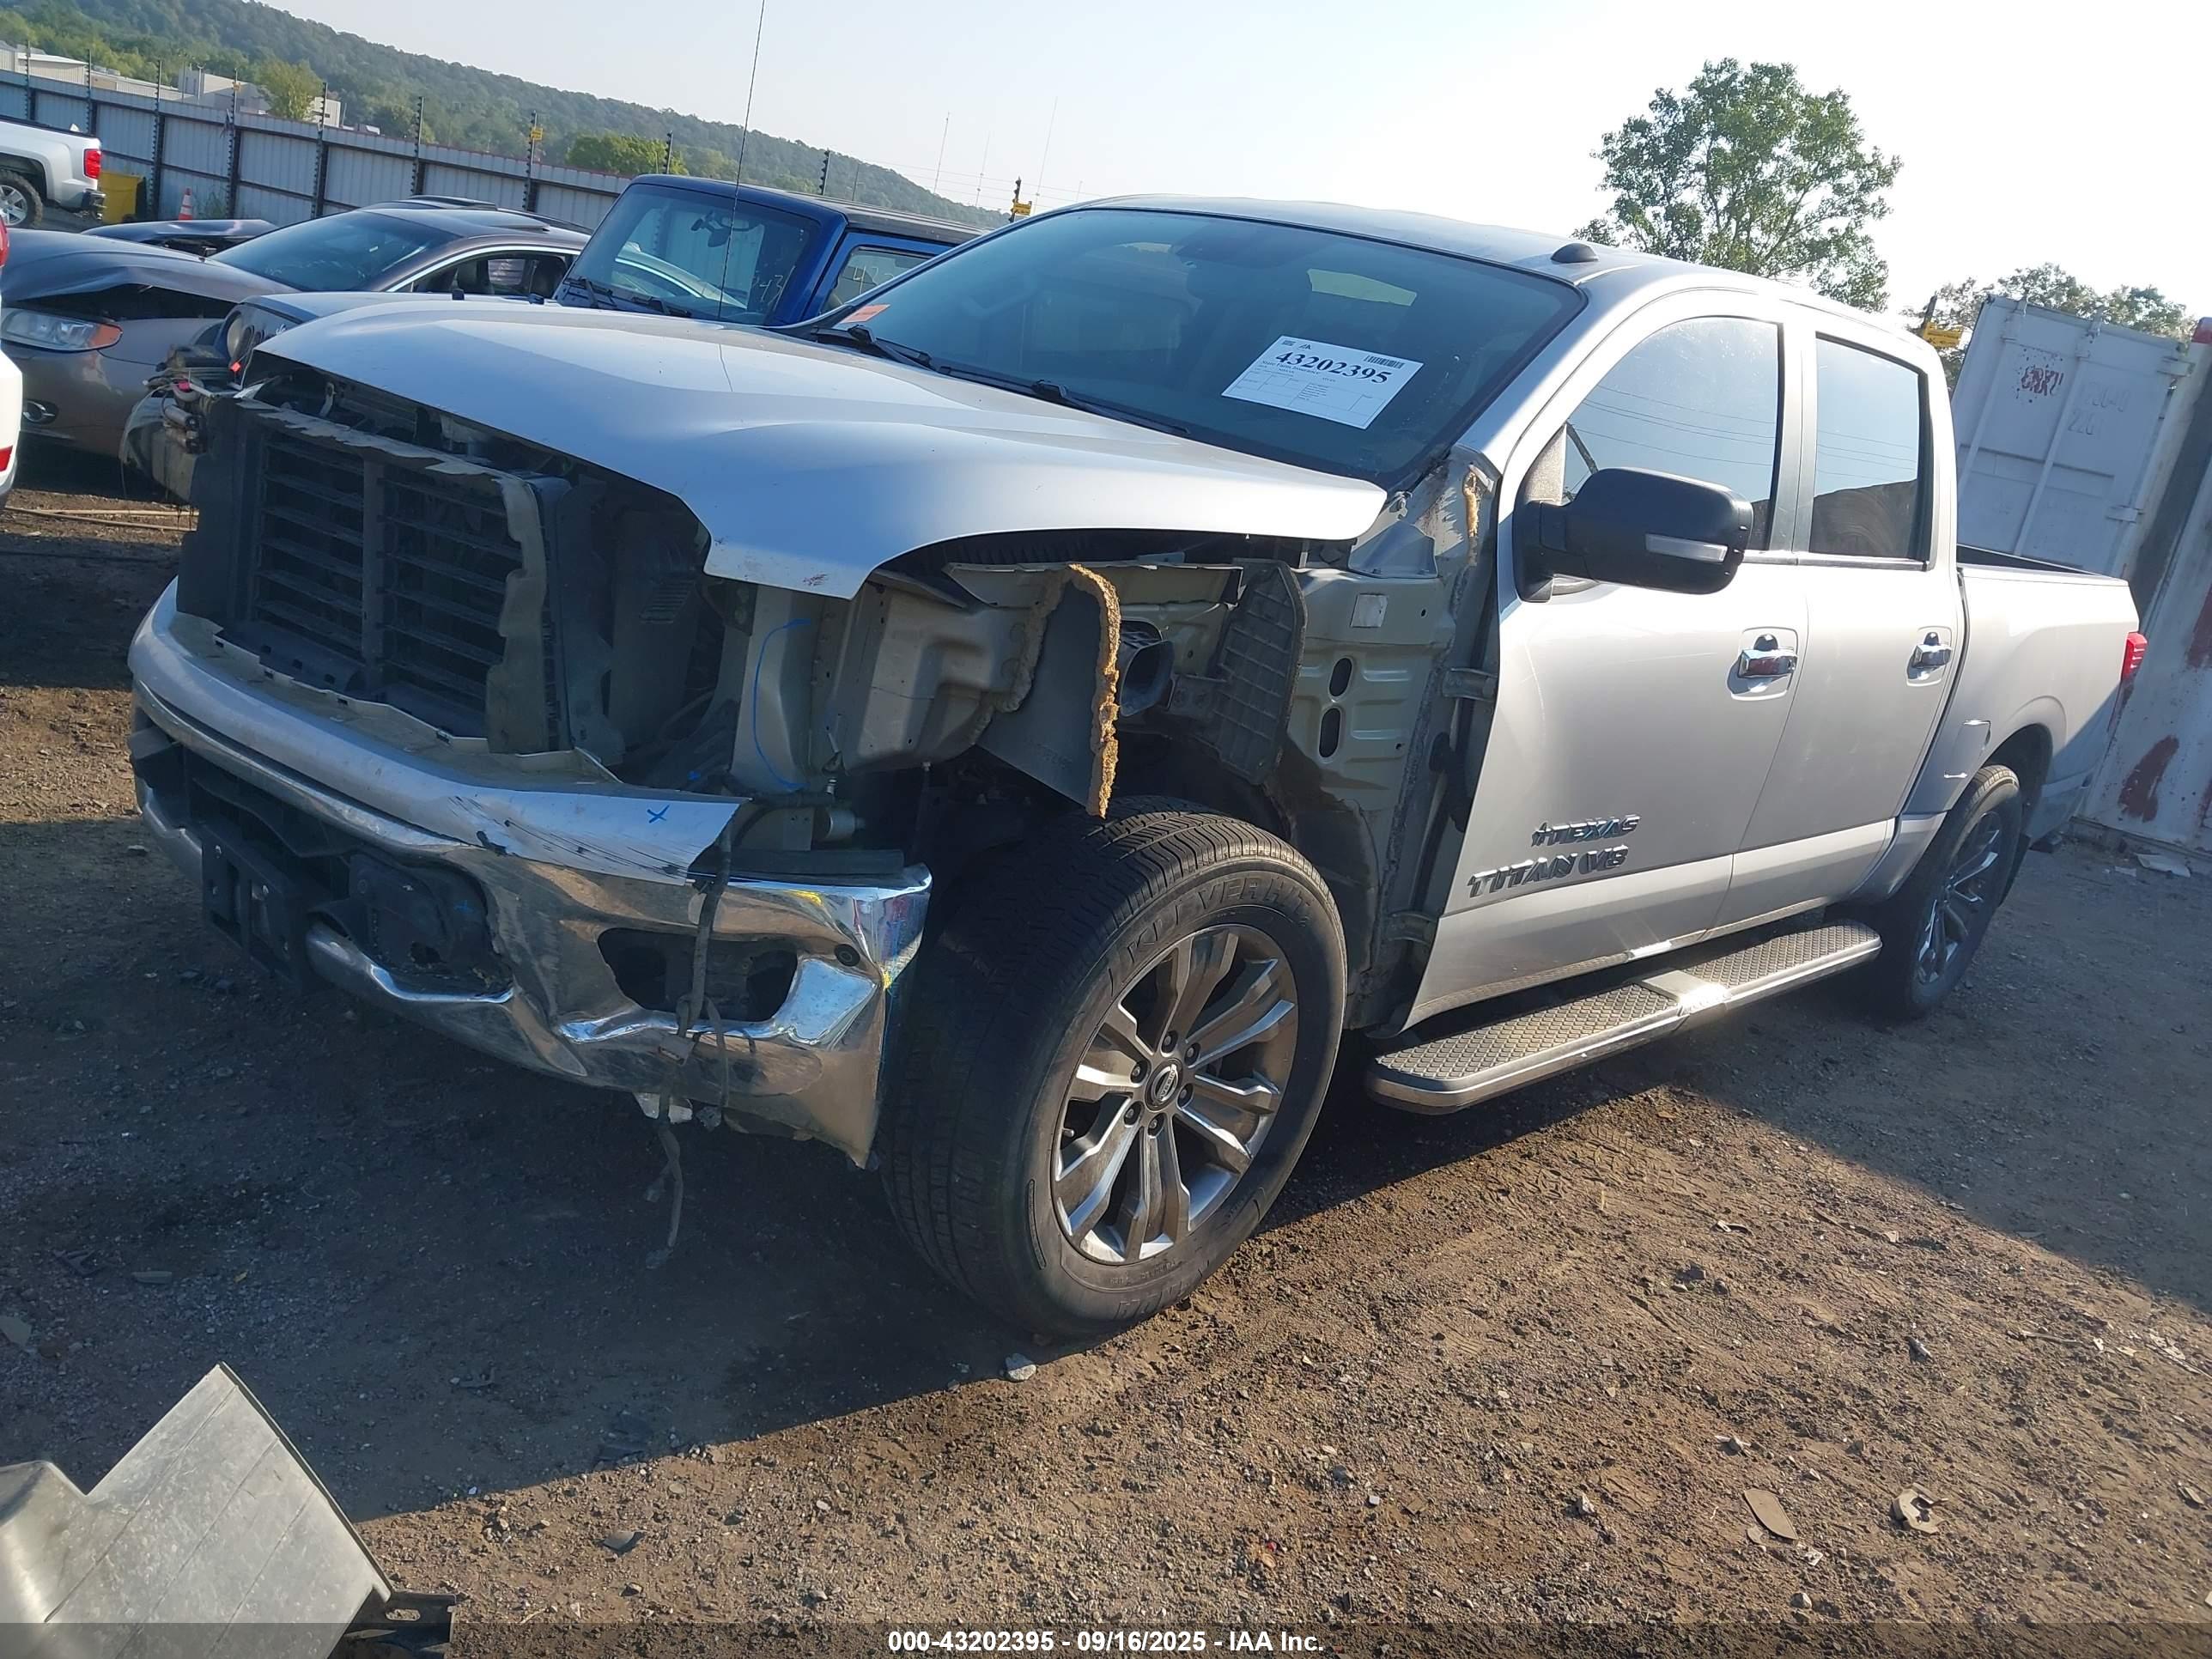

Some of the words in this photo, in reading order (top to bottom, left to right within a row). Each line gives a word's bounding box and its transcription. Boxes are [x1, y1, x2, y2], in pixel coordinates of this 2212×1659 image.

[1276, 351, 1393, 384] 43202395
[1548, 814, 1641, 846] TEXAS
[1467, 853, 1578, 898] TITAN
[1578, 844, 1629, 875] V8
